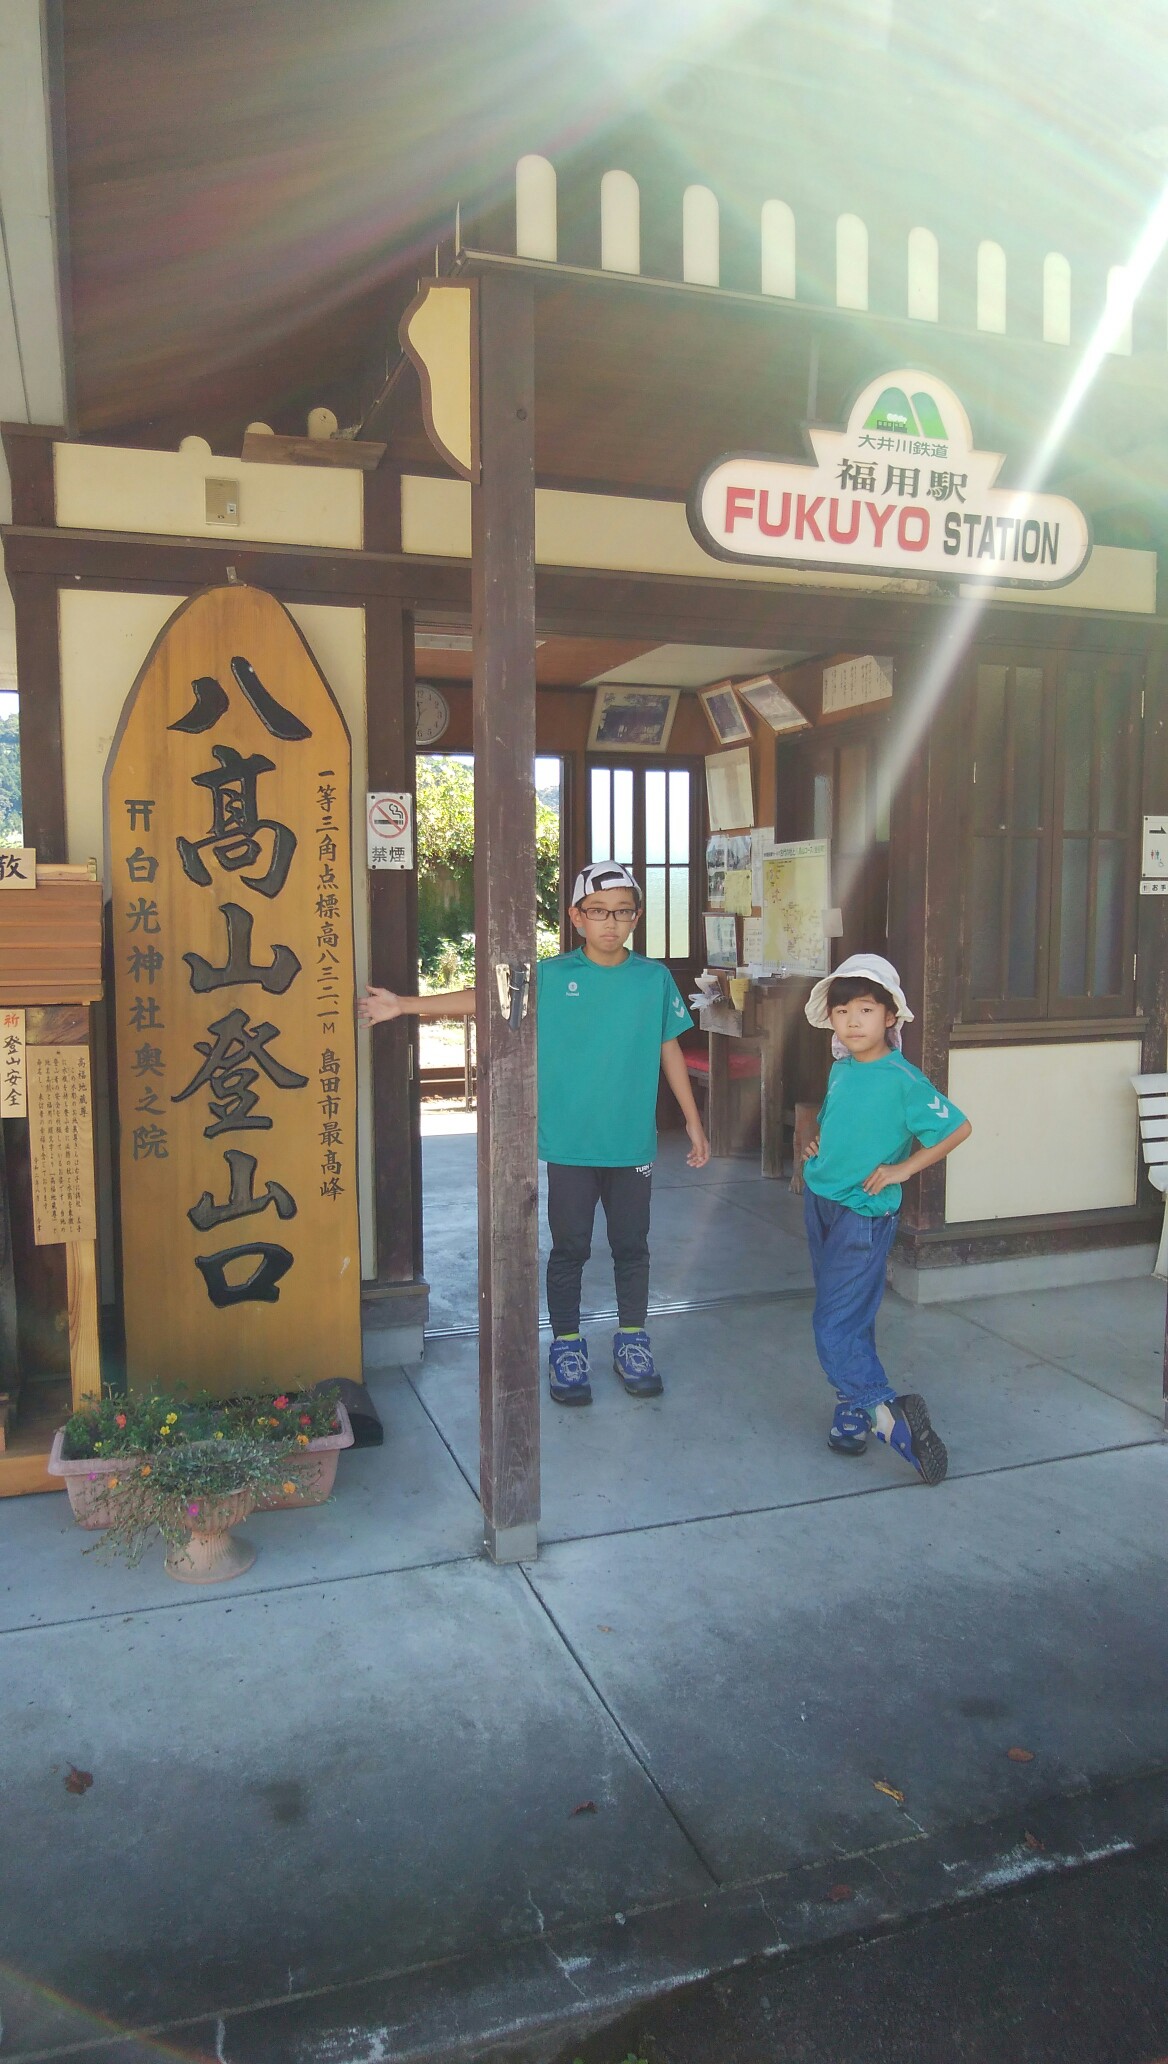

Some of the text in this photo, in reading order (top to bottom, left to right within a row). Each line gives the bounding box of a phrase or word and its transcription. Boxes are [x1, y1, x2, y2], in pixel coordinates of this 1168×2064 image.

[858, 434, 948, 459] 大井川鉄道
[836, 457, 968, 503] 福用駅
[724, 486, 1060, 565] FUKUYO STATION
[372, 846, 406, 863] 禁煙
[2, 1035, 23, 1107] 登山安全
